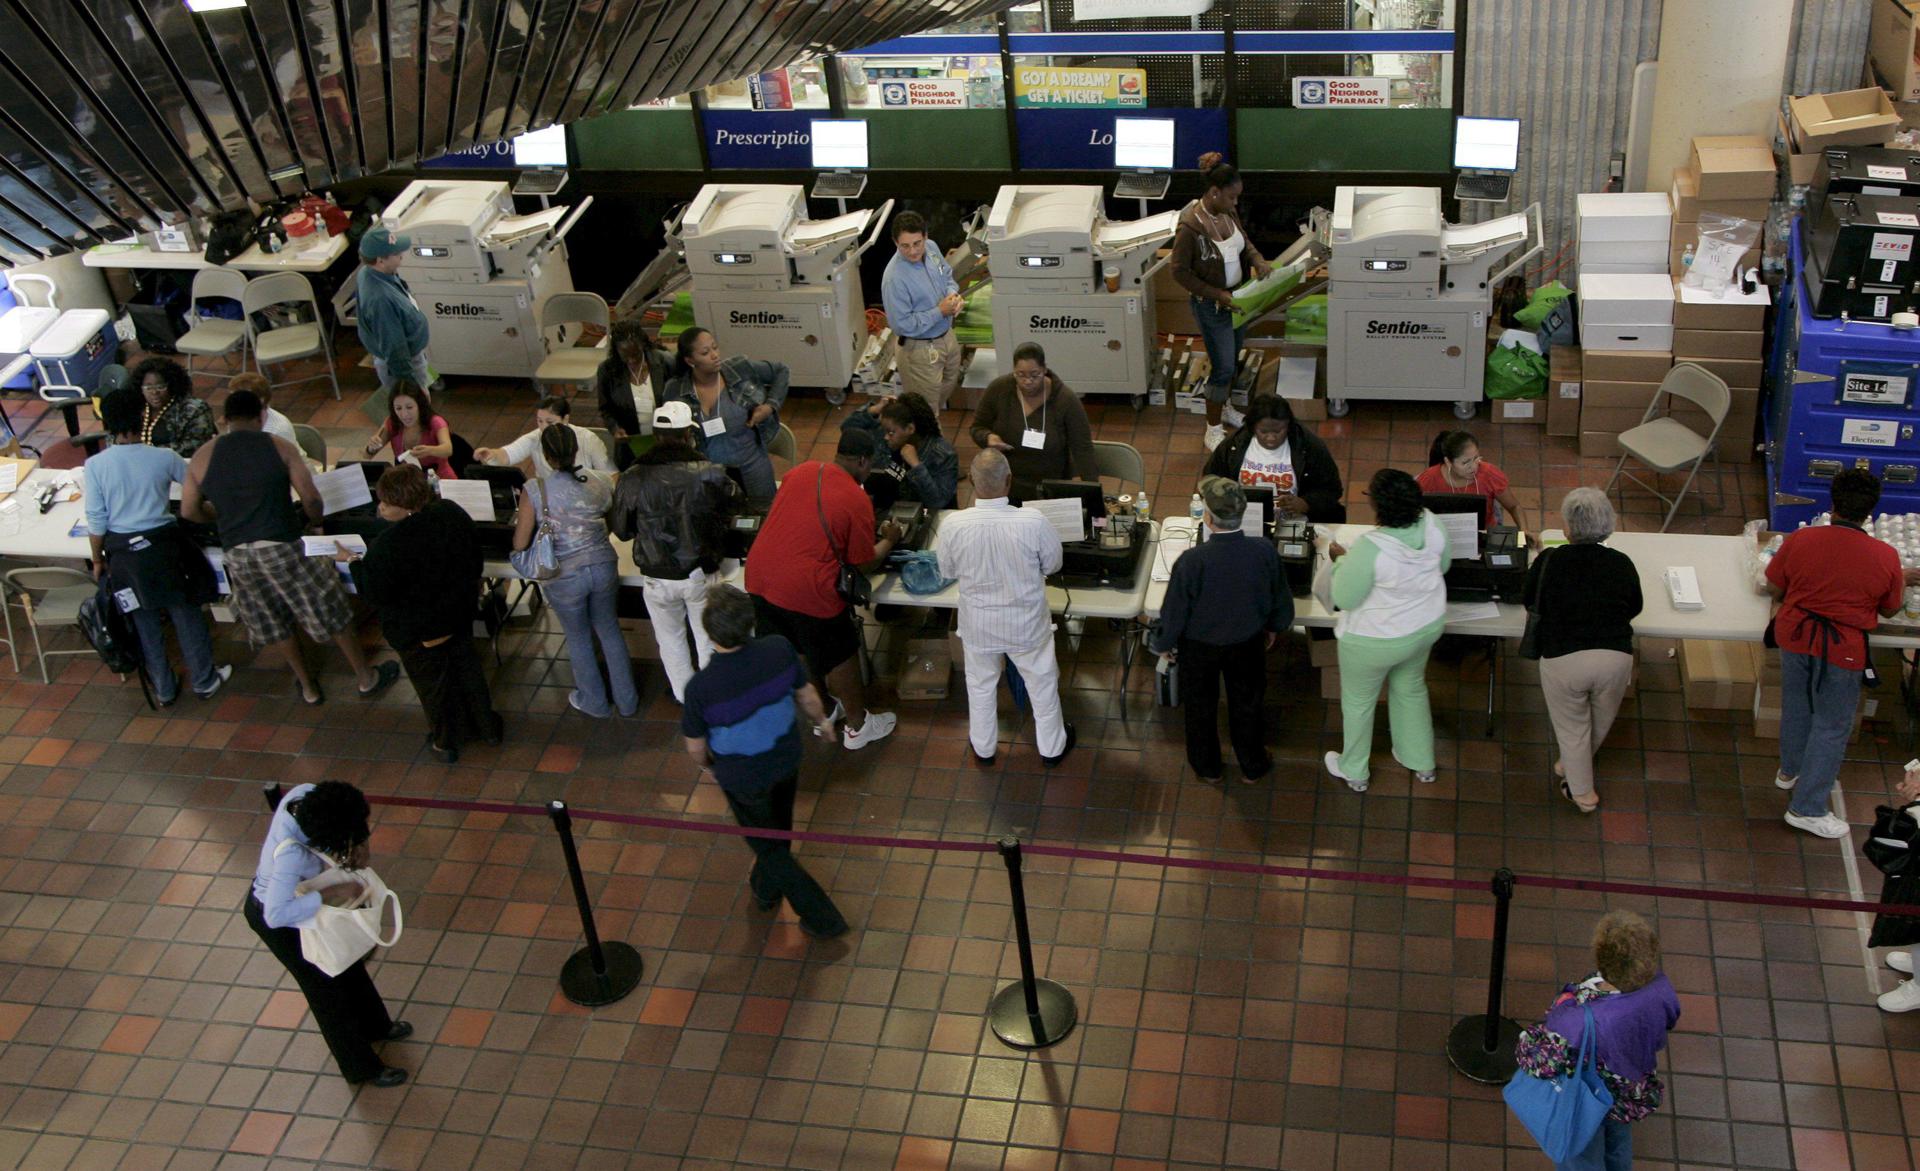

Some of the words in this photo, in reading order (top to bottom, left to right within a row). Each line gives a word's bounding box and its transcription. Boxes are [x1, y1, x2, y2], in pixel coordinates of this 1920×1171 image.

[1021, 71, 1047, 86] GOT
[1050, 72, 1060, 86] A
[1062, 72, 1112, 88] DREAM?
[1329, 81, 1360, 89] GOOD
[1028, 89, 1050, 103] GET
[1053, 90, 1063, 103] A
[1329, 89, 1379, 97] NEIGHBOR
[434, 302, 479, 316] Sentio
[730, 310, 777, 324] Sentio
[1030, 315, 1080, 328] Sentio
[1366, 320, 1420, 334] Sentio
[1847, 380, 1871, 391] Site
[1873, 382, 1888, 393] 14
[1851, 435, 1887, 444] Elections
